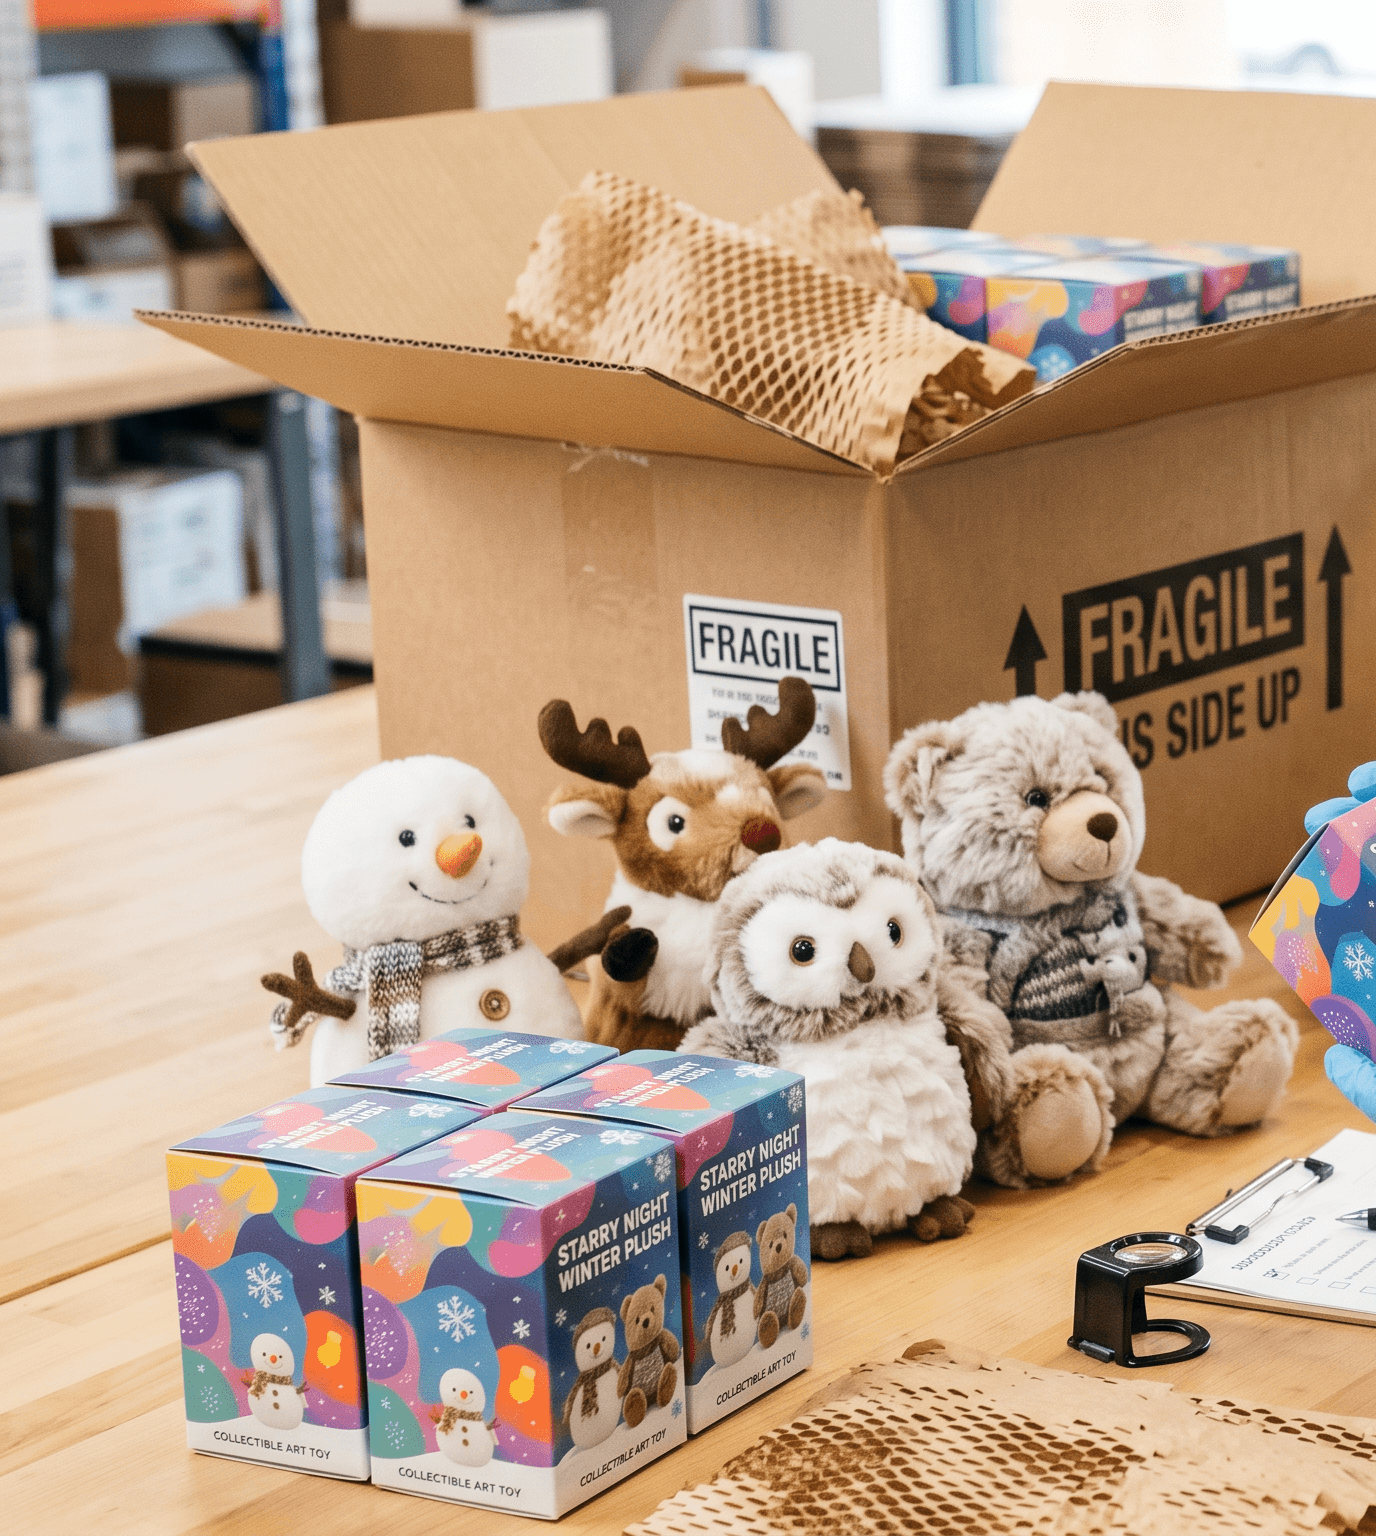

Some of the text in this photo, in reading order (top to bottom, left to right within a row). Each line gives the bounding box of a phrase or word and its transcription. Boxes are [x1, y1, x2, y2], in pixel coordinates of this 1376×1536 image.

[699, 622, 831, 674] FRAGILE
[1079, 553, 1293, 691] FRAGILE
[1119, 666, 1300, 771] IS SIDE UP
[700, 1123, 800, 1192] STARRY NIGHT
[701, 1148, 801, 1217] WINTER PLUSH
[558, 1191, 669, 1267] STARRY NIGHT
[558, 1216, 672, 1293] WINTER PLUSH
[767, 1359, 782, 1376] ART
[782, 1350, 797, 1366] TOY
[213, 1430, 331, 1460] COLLECTIBLE ART TOY
[634, 1438, 650, 1456] ART
[651, 1427, 667, 1445] TOY
[398, 1467, 522, 1498] COLLECTIBLE ART TOY
